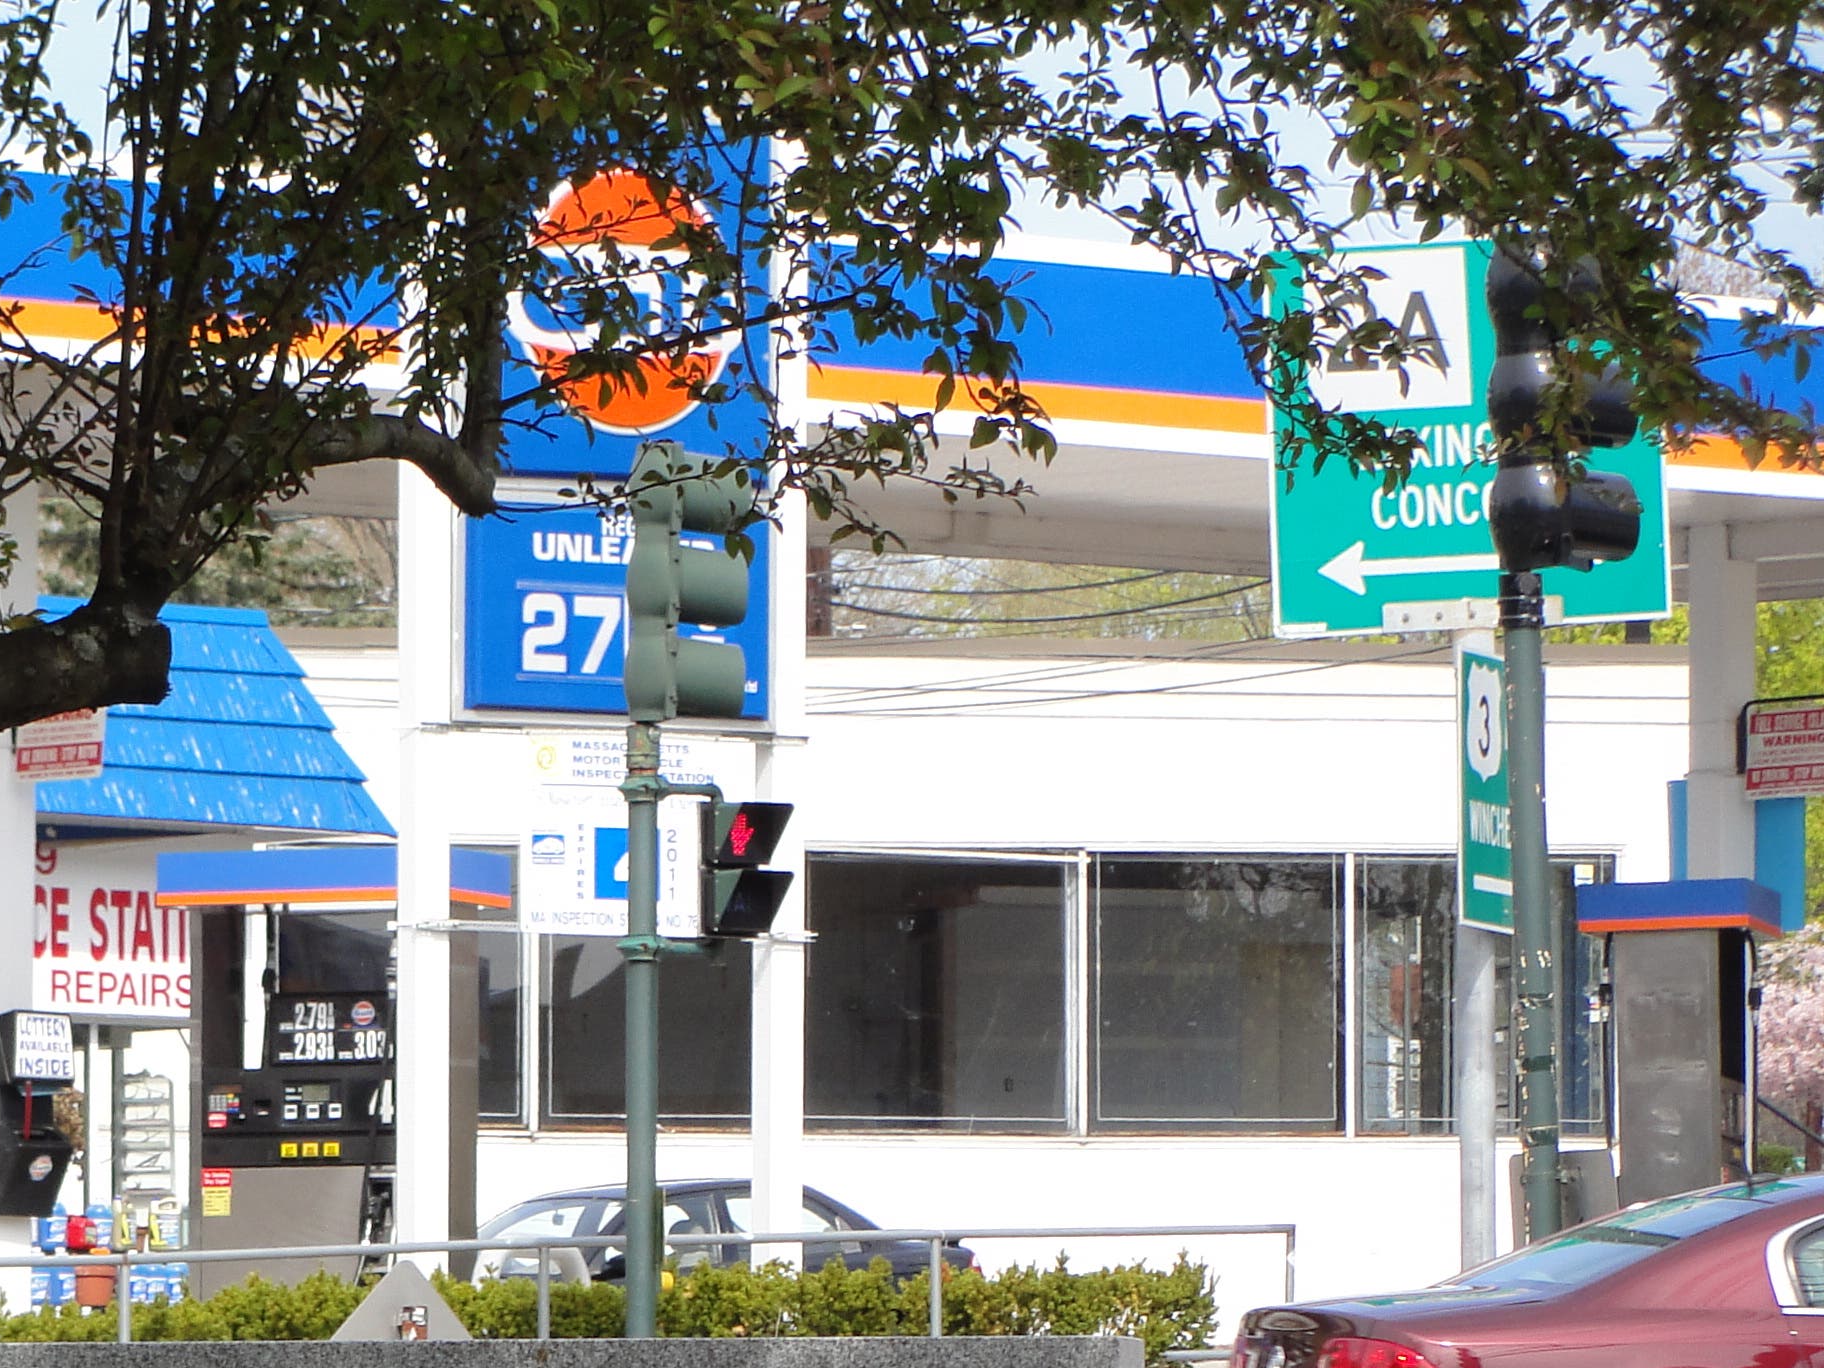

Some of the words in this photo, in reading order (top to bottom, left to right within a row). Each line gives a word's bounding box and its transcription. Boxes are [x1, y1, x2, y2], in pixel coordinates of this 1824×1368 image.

[1371, 481, 1493, 529] CONC
[1478, 695, 1491, 758] 3
[572, 741, 689, 754] MASSACETTS
[573, 755, 620, 765] MOTOR
[664, 772, 714, 783] TATION
[1469, 799, 1511, 849] WINCHE
[51, 969, 191, 1008] REPAIRS
[20, 1016, 66, 1036] LOTTERY
[20, 1041, 70, 1053] AVAILABLE
[19, 1058, 71, 1075] INSIDE
